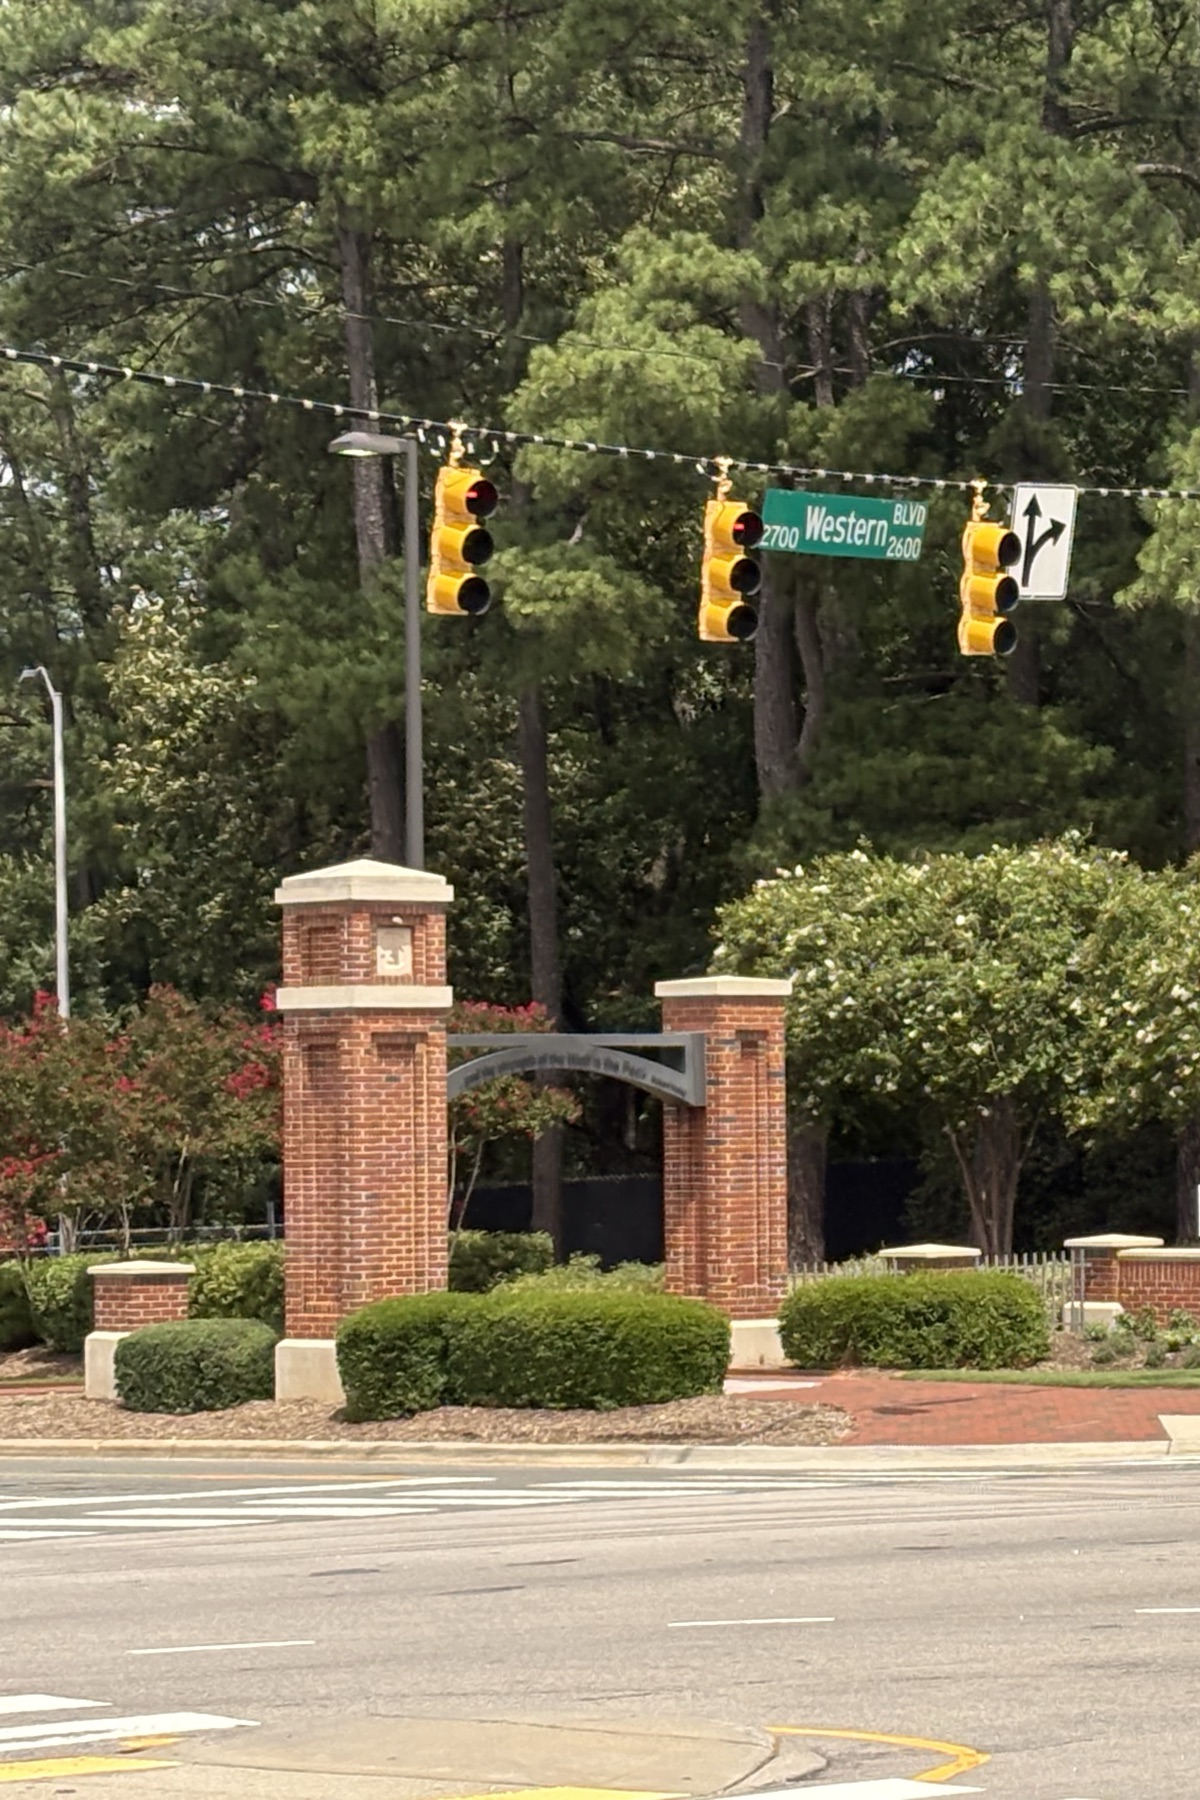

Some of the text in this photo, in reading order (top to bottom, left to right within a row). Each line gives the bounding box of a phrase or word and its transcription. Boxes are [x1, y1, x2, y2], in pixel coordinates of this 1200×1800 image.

[760, 524, 799, 549] 2700
[805, 503, 926, 547] Western BLVD
[886, 536, 922, 558] 2600
